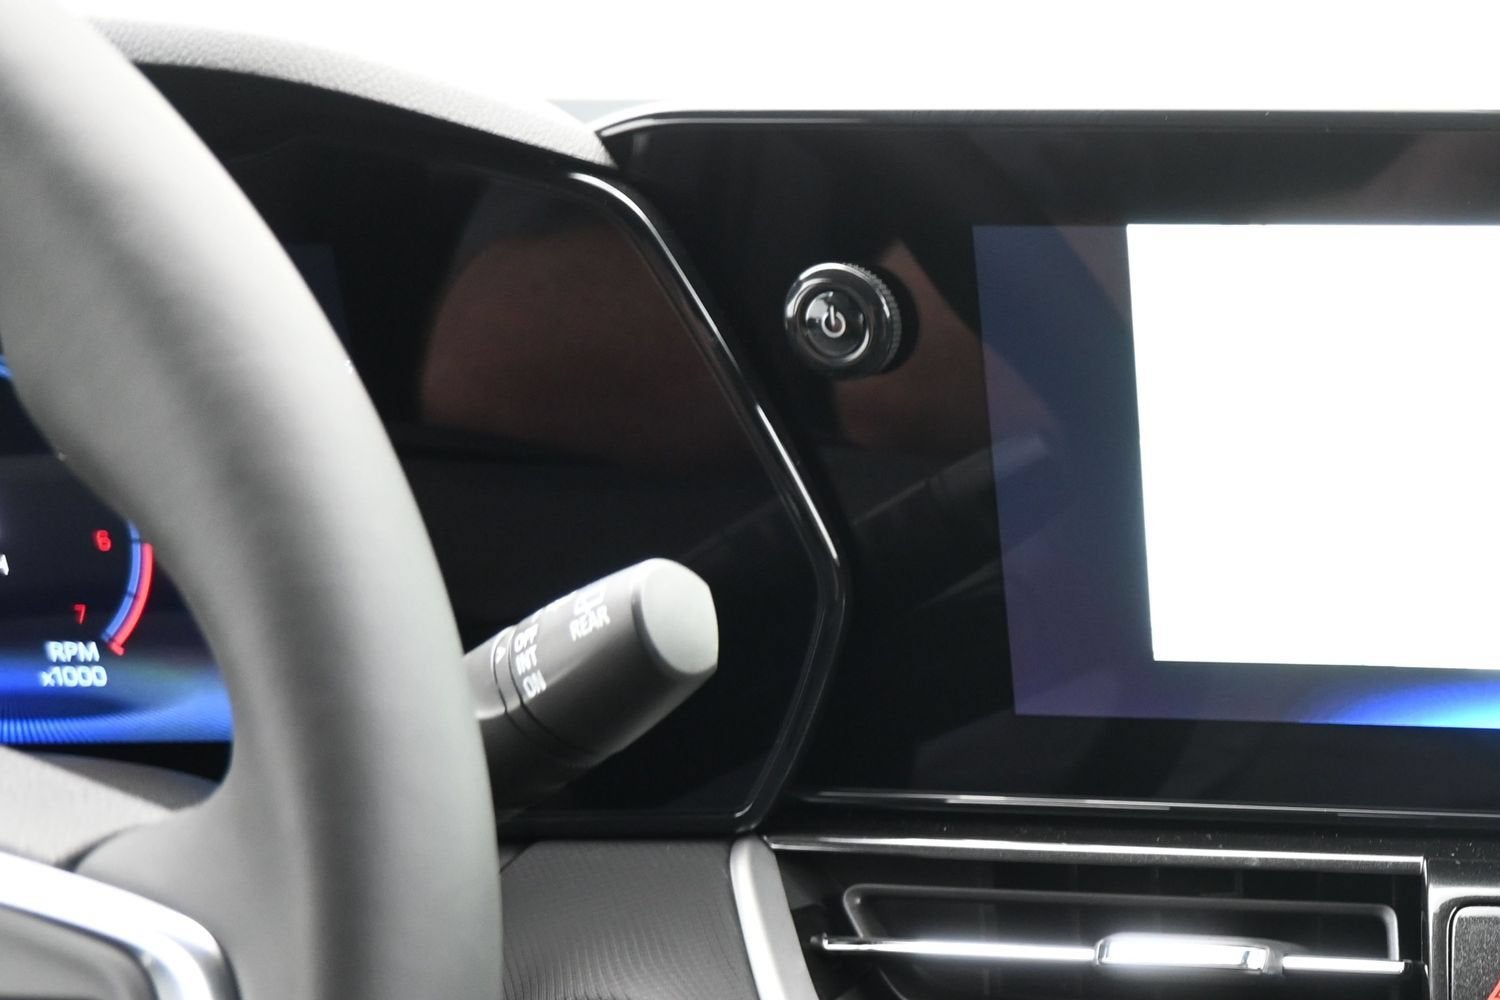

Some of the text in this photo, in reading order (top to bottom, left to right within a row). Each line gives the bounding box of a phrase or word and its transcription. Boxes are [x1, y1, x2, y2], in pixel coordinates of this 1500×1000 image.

[95, 530, 112, 551] 6
[73, 603, 86, 624] 7
[569, 605, 611, 642] REAR
[45, 641, 100, 662] RPM
[515, 644, 537, 676] INT
[40, 665, 107, 687] x1000
[522, 670, 547, 698] ON
